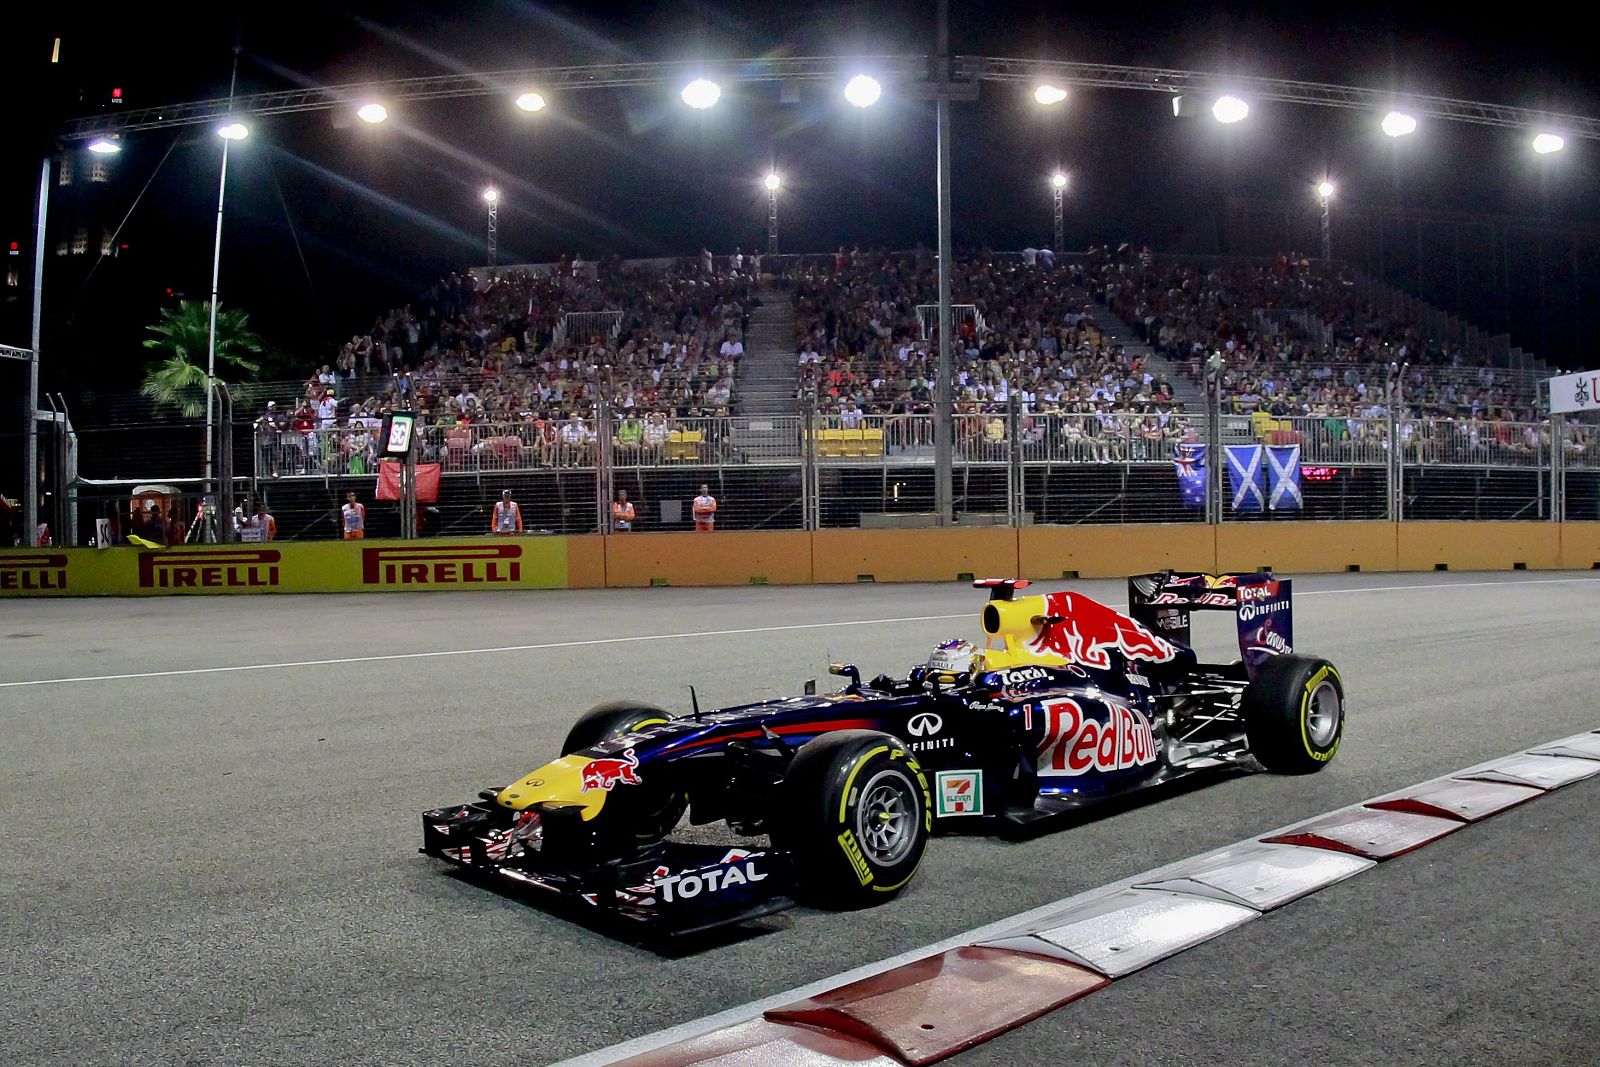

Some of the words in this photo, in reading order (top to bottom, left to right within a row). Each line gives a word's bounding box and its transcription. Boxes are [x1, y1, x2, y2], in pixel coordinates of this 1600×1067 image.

[100, 523, 109, 544] SC
[139, 550, 281, 587] PIRELLI
[363, 544, 522, 584] PIRELLI
[1238, 586, 1271, 600] TOTAL
[1256, 600, 1290, 616] INFINITI
[997, 667, 1055, 686] TOTAL
[1023, 704, 1032, 730] 1
[1037, 697, 1117, 776] Red
[1118, 704, 1156, 770] Bull
[890, 749, 905, 760] P
[906, 757, 932, 832] ZERO
[946, 779, 970, 794] 7
[655, 862, 768, 902] TOTAL
